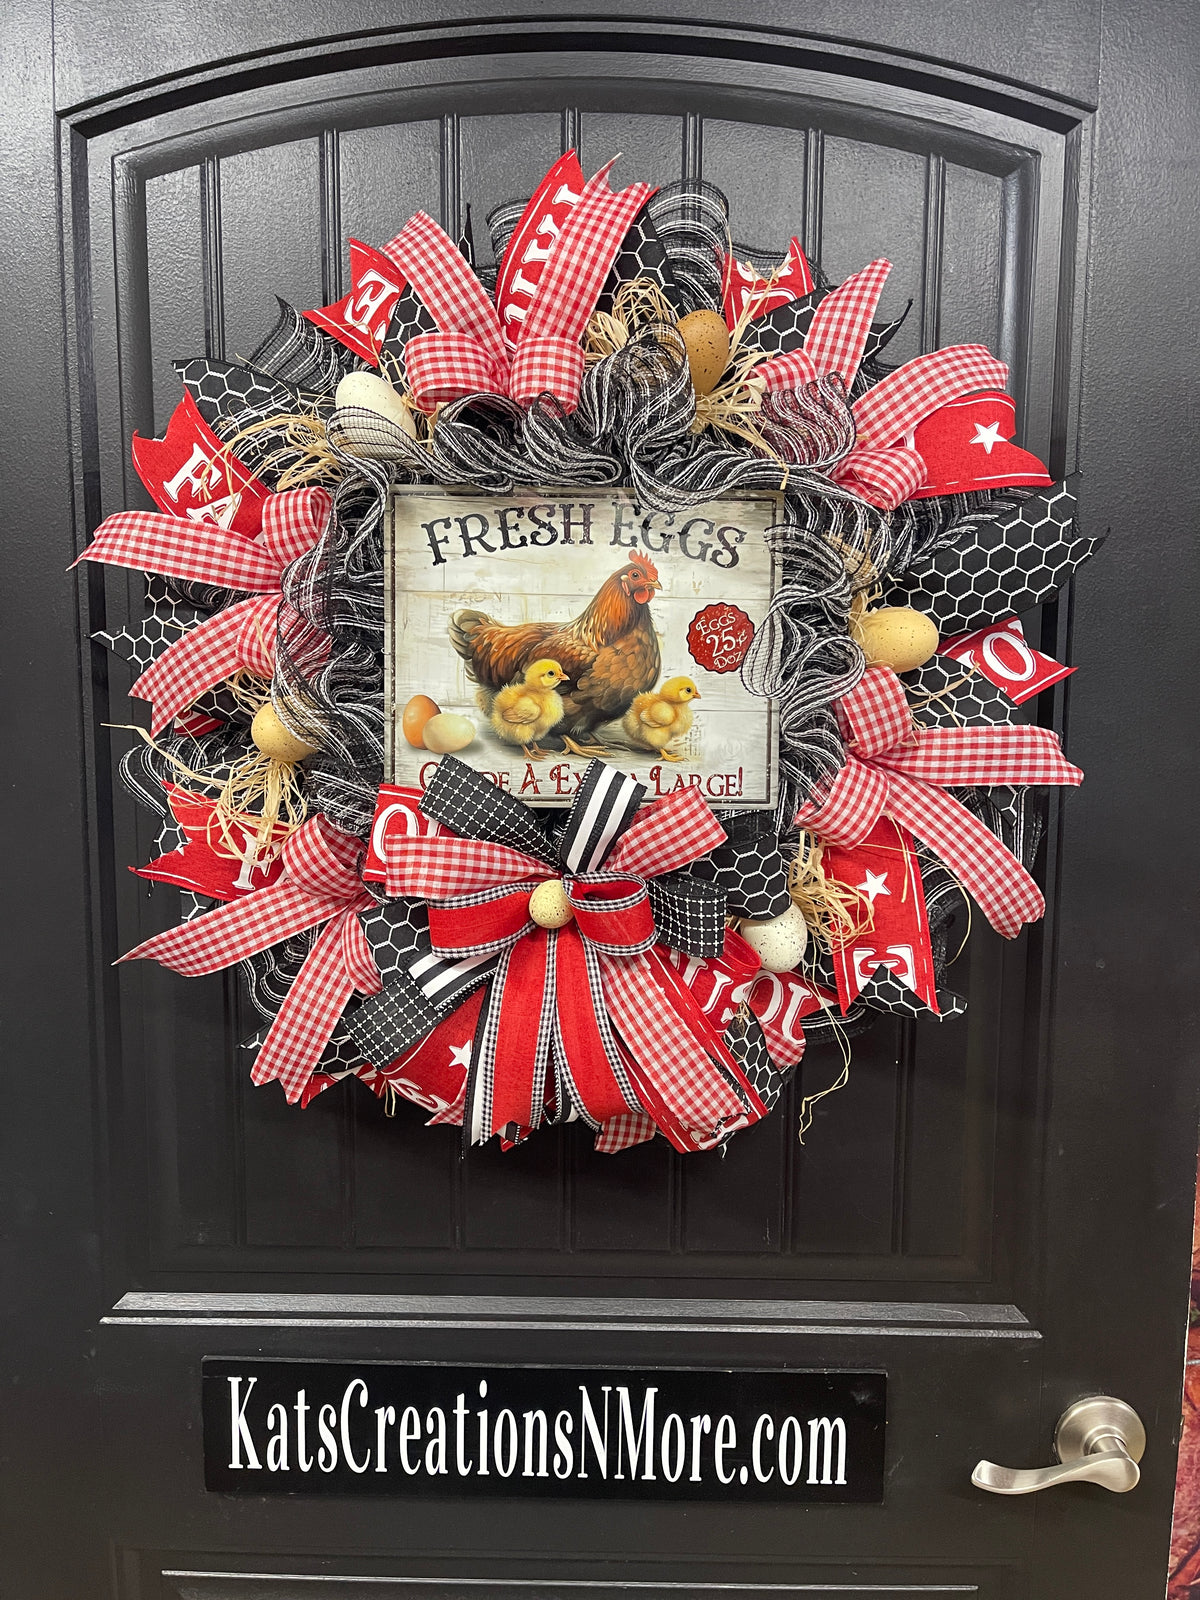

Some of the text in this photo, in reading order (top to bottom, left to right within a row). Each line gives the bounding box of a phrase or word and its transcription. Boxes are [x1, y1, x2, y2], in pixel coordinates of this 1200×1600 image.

[421, 502, 747, 569] FRESH EGGS
[696, 612, 736, 636] EGGS
[518, 763, 543, 794] A
[649, 765, 743, 797] LARGE!
[227, 1376, 848, 1487] KatsCreationsNMore.com
